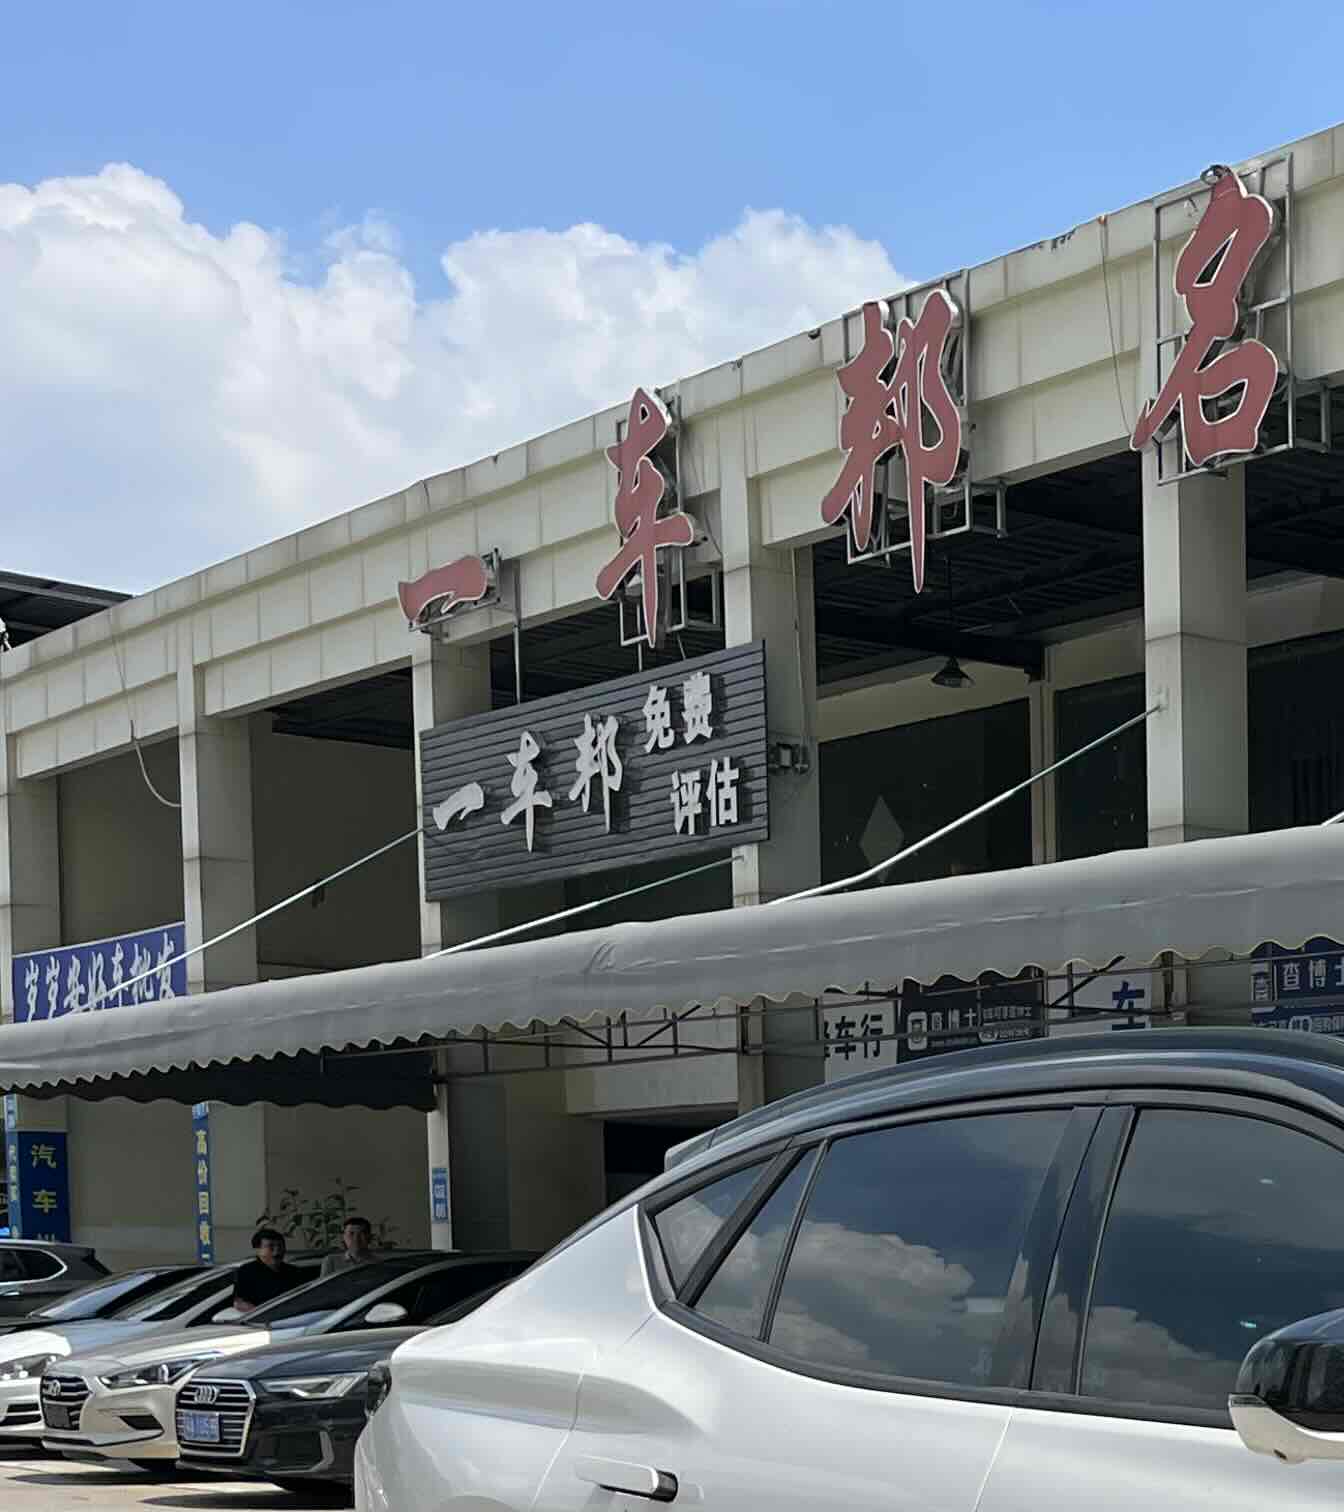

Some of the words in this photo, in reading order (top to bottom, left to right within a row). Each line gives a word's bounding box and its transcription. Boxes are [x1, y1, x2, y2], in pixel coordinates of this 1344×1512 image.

[432, 713, 623, 854] 一车邦
[643, 672, 713, 753] 免费
[670, 757, 740, 836] 评估
